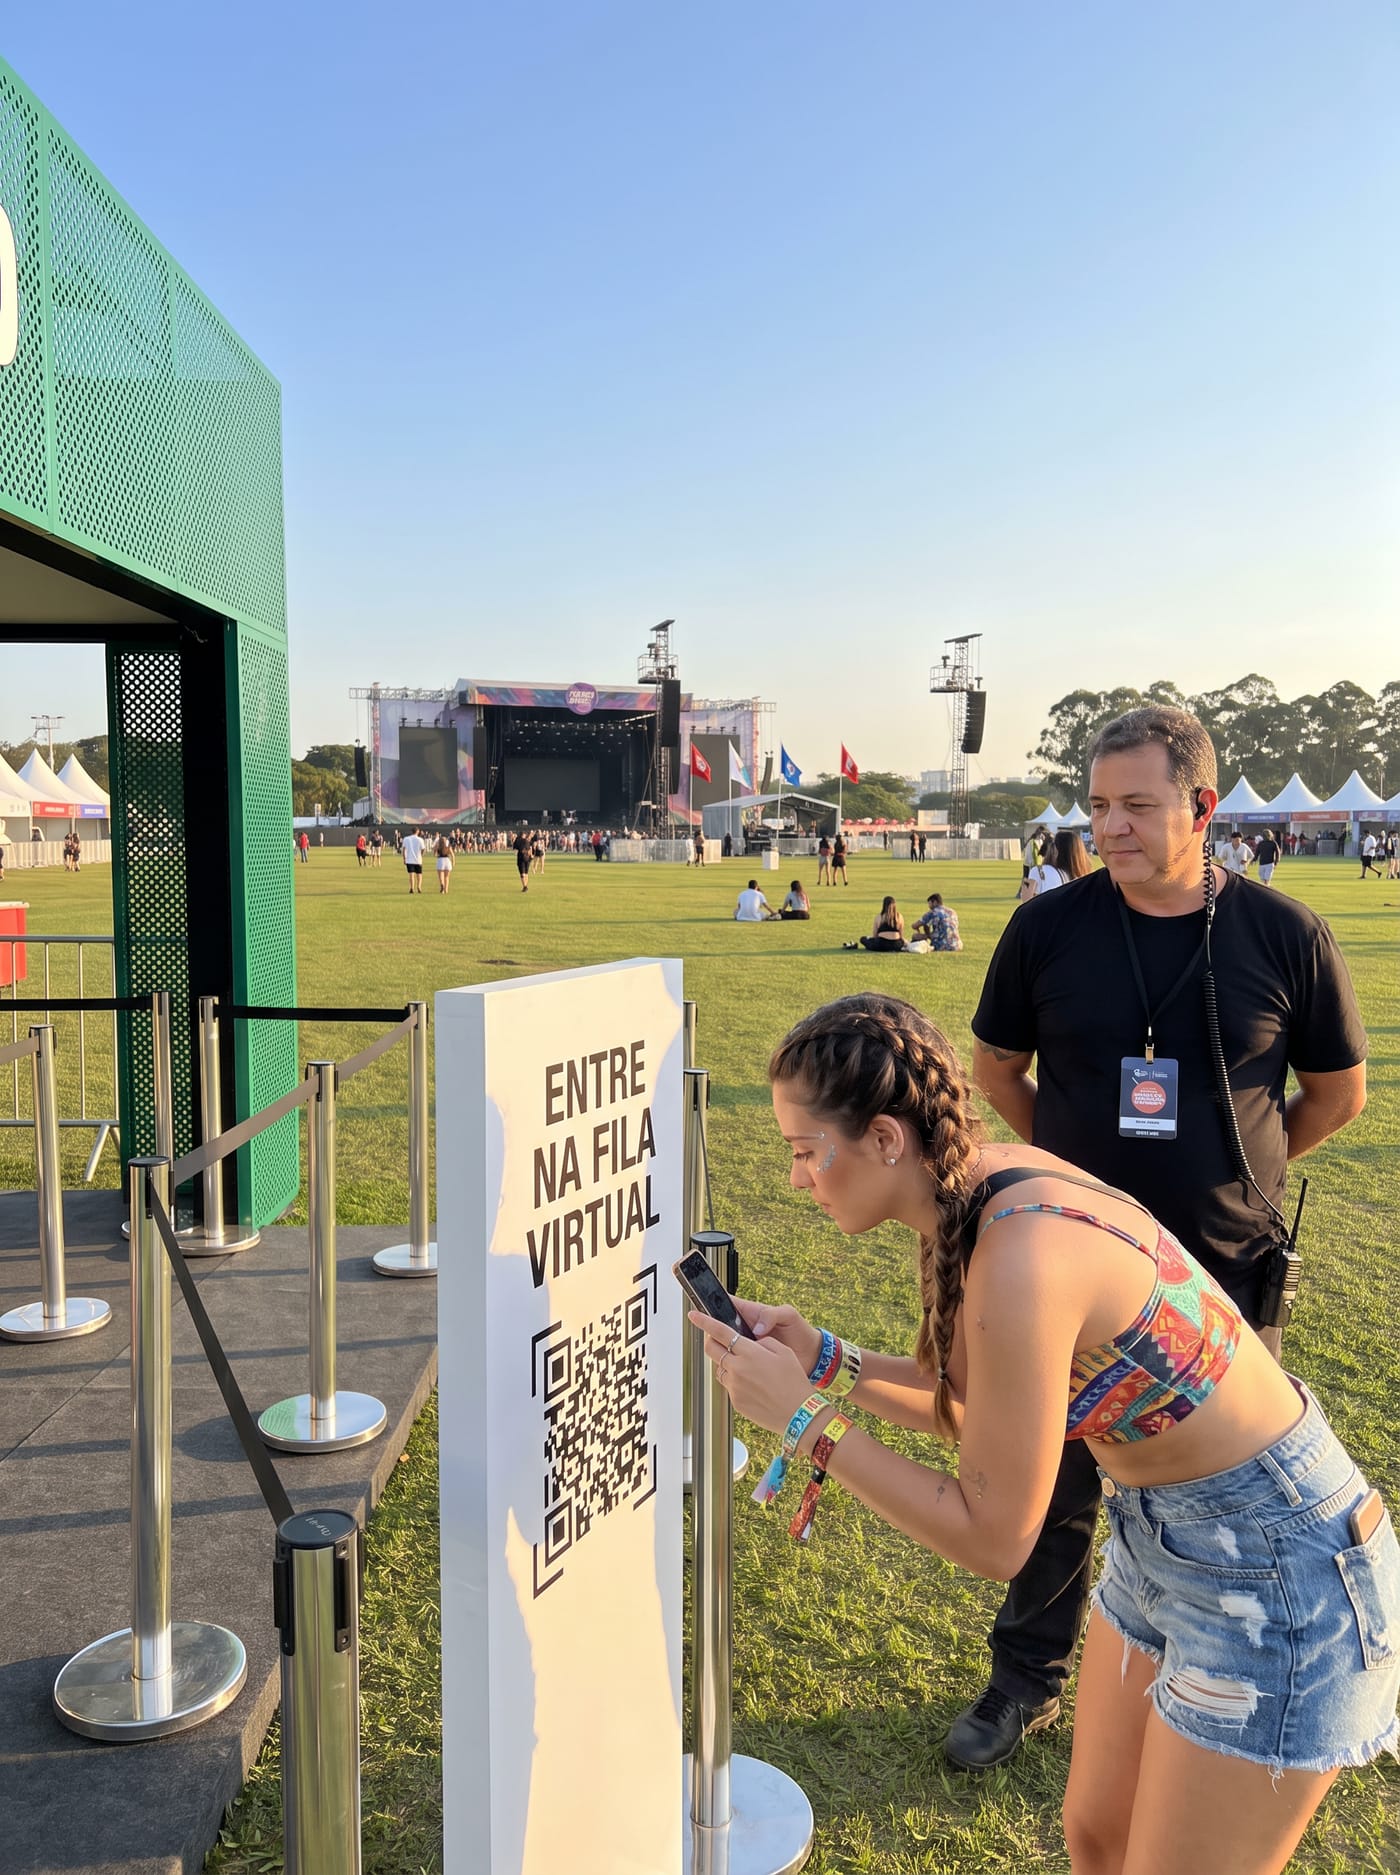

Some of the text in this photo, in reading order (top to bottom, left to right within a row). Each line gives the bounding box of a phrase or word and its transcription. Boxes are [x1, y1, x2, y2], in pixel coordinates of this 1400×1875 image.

[545, 1039, 646, 1126] ENTRE
[533, 1106, 657, 1210] NA FILA
[526, 1174, 661, 1289] VIRTUAL
